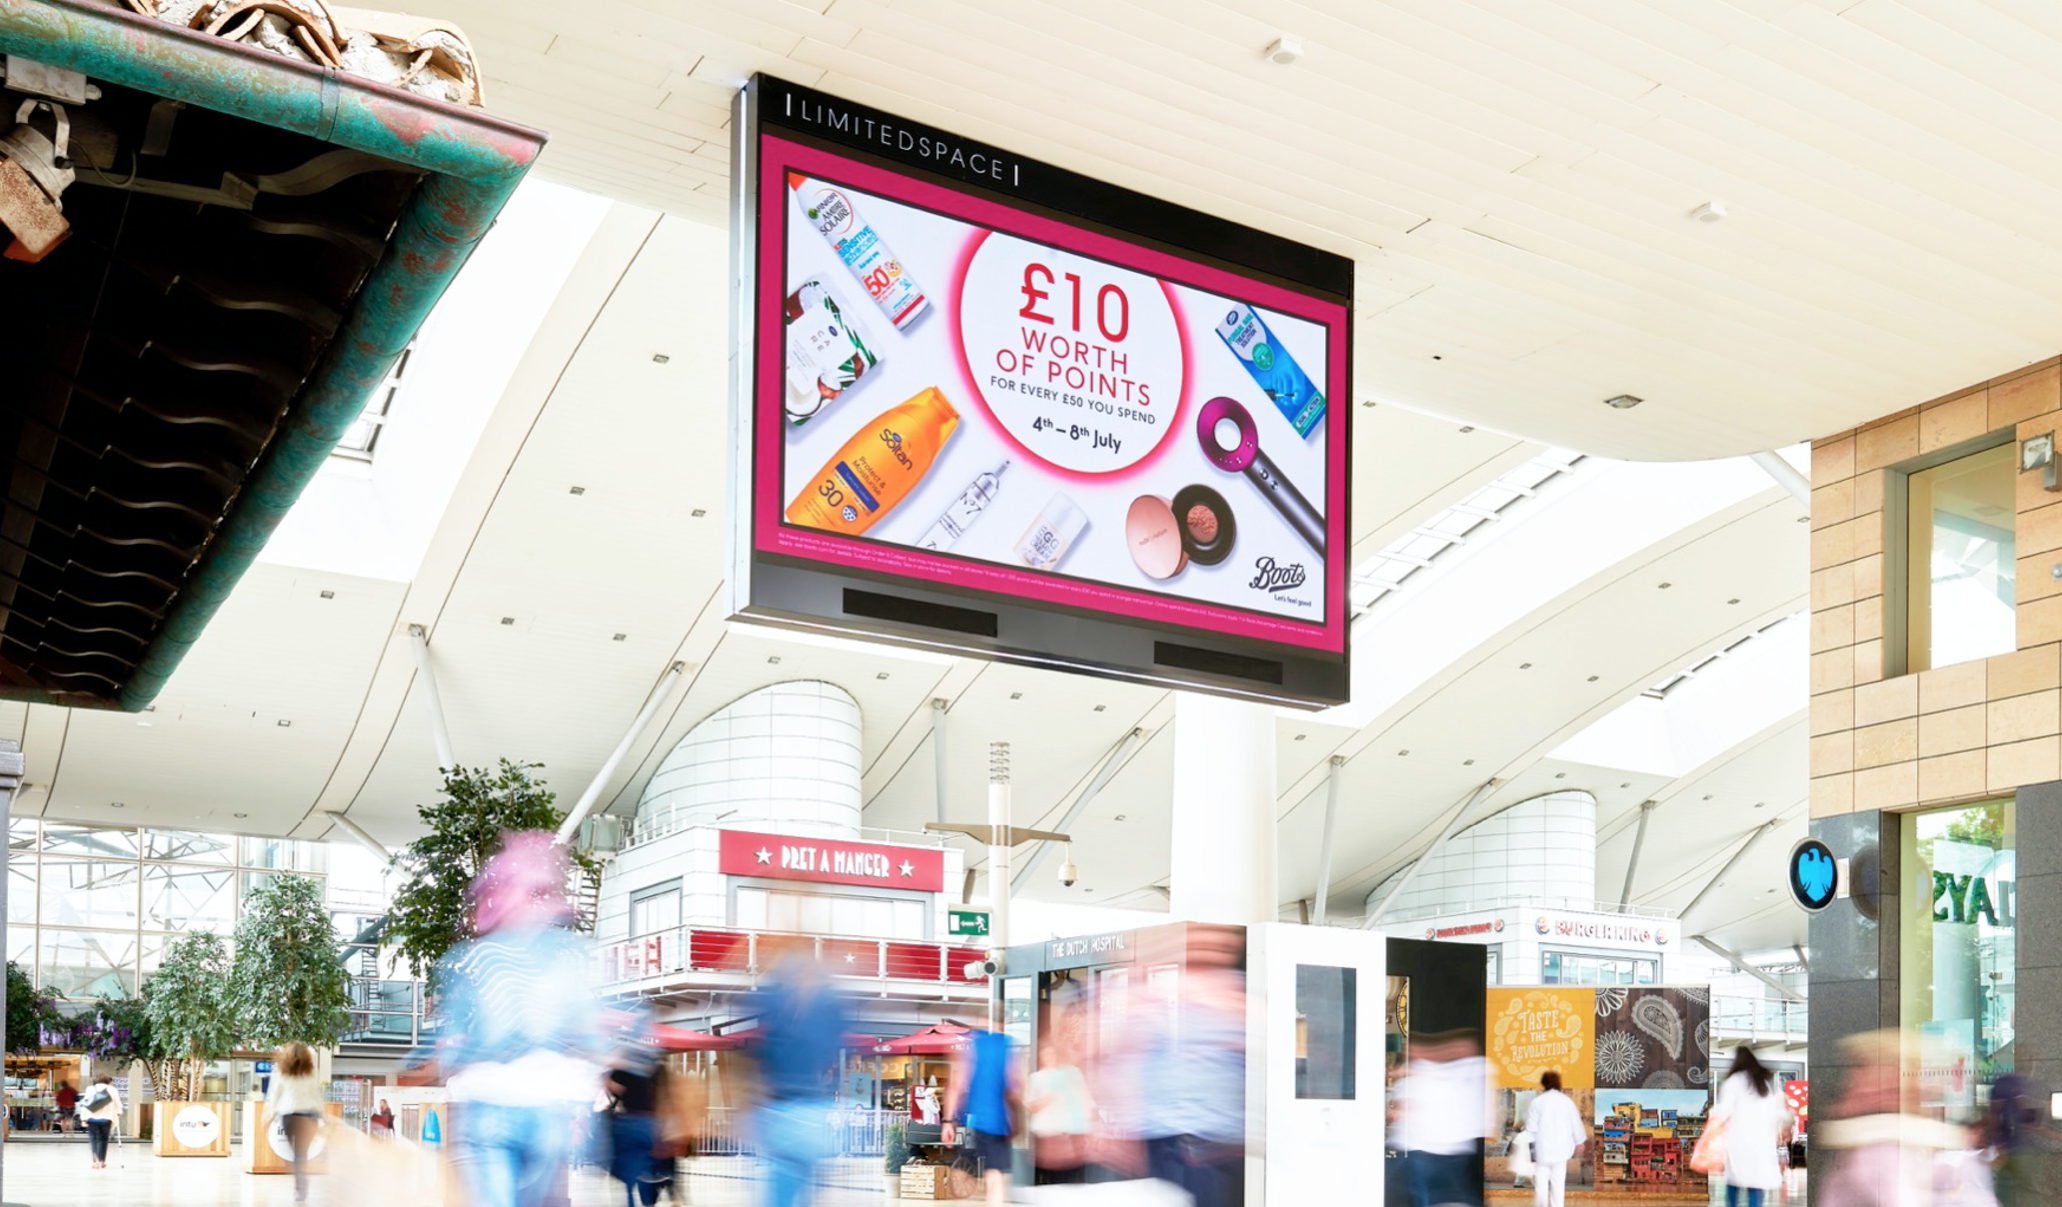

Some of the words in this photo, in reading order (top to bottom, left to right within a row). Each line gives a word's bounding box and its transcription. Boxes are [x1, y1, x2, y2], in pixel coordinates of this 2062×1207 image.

[801, 100, 1003, 180] LIMITEDSPACE
[819, 207, 851, 236] SOLAIRE
[837, 225, 873, 258] SENSITIVE
[1019, 263, 1129, 343] £10
[1021, 326, 1127, 375] WORTH
[996, 348, 1034, 376] OF
[1048, 360, 1151, 407] POINTS
[990, 375, 1016, 391] FOR
[1020, 383, 1058, 401] EVERY
[1062, 393, 1084, 408] £50
[1088, 399, 1114, 415] YOU
[1117, 407, 1156, 425] SPEND
[879, 428, 914, 471] Soltan
[1032, 416, 1054, 432] 4th
[1069, 424, 1090, 441] 8th
[1092, 430, 1122, 454] July
[817, 479, 845, 508] 30
[1248, 556, 1306, 593] Boots
[781, 845, 817, 871] PRET
[820, 849, 830, 872] A
[834, 850, 889, 878] MANGER
[1052, 942, 1064, 958] THE
[1066, 939, 1088, 956] DUTCH
[1091, 934, 1125, 953] HOSPITAL
[1556, 920, 1612, 939] BURGER
[1615, 925, 1651, 942] KING
[1517, 1009, 1559, 1033] TASTE
[1530, 1031, 1547, 1042] THE
[1511, 1041, 1568, 1062] REVOLUTION
[179, 1120, 197, 1128] intu
